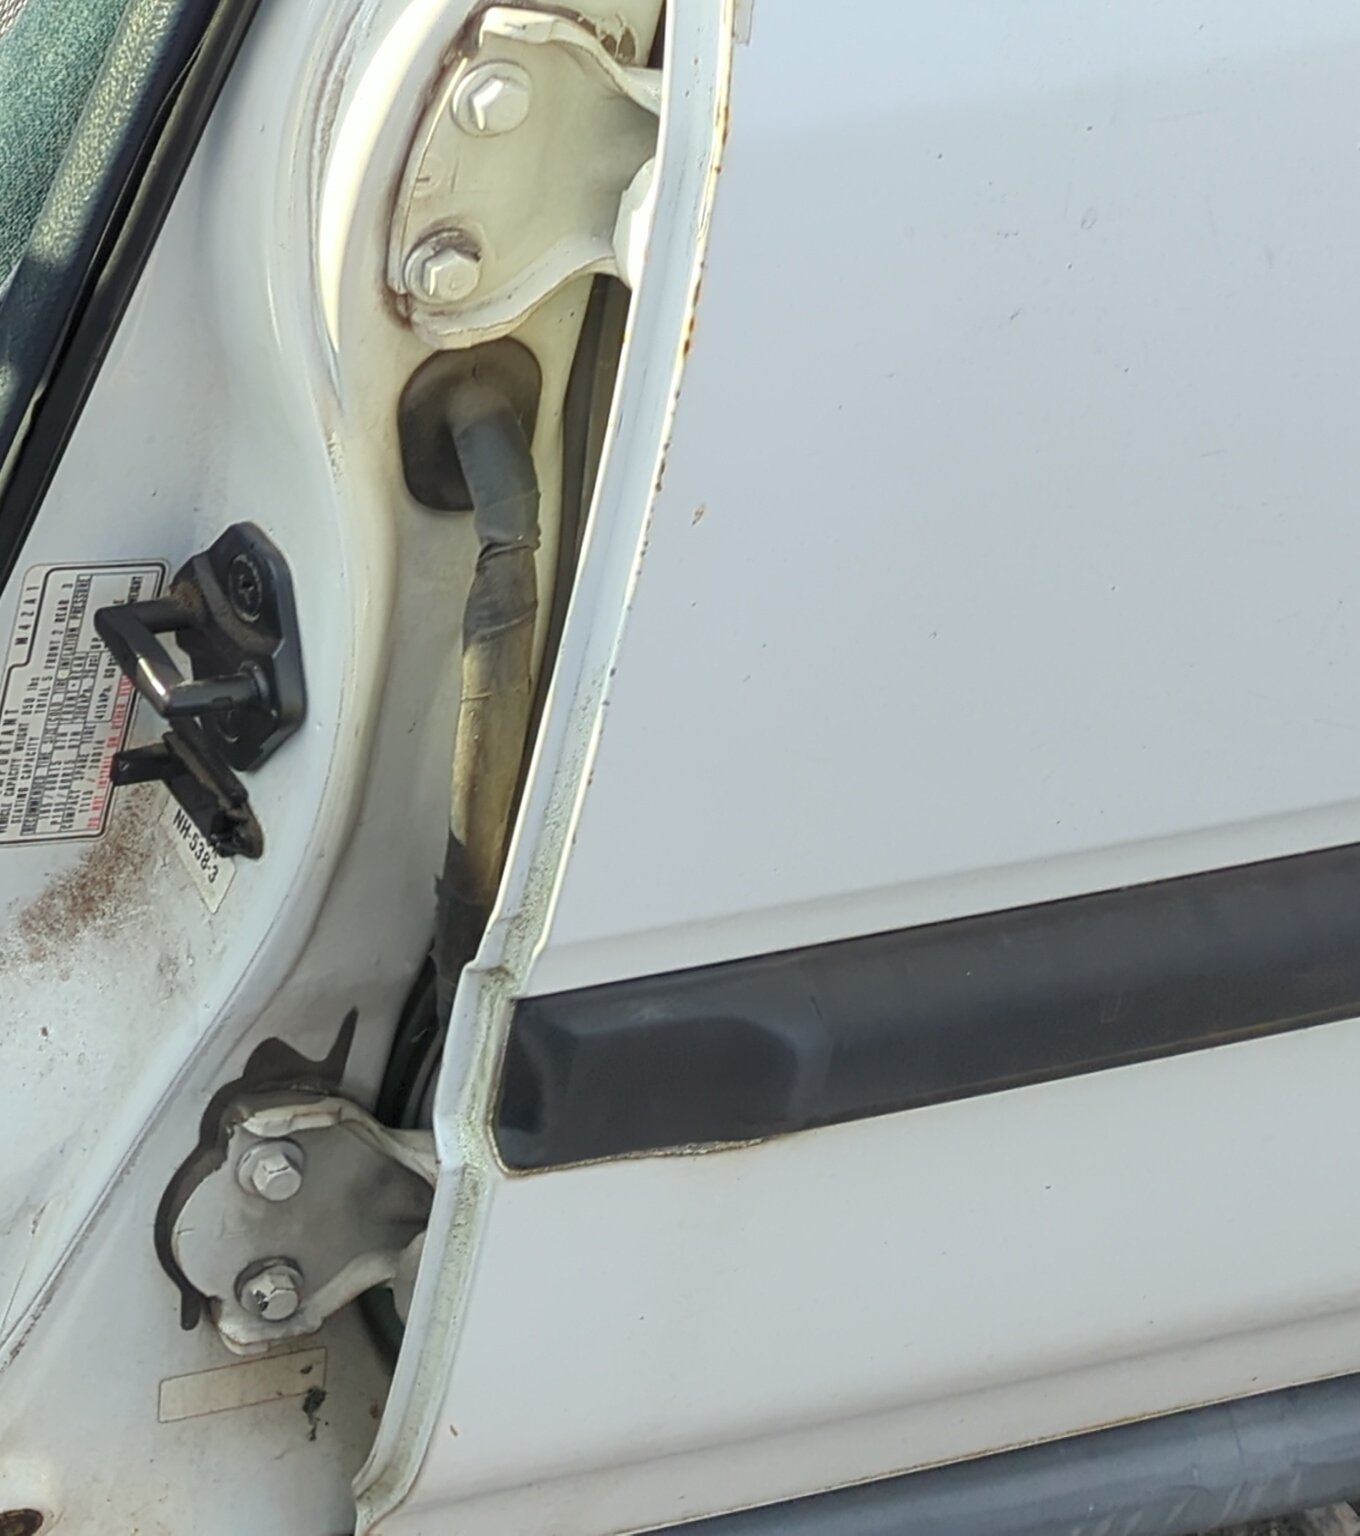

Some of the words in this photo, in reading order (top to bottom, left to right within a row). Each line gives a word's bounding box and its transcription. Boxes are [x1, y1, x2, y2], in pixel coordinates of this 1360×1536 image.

[53, 599, 70, 622] REAR
[43, 640, 61, 669] FRONT
[25, 676, 40, 691] lbs
[33, 686, 51, 713] TOTAL
[12, 722, 30, 752] WEIGHT
[19, 735, 40, 779] CAPACITY
[3, 757, 22, 796] CAPACITY
[10, 787, 29, 824] SEATING
[61, 789, 81, 829] COMPACT
[172, 808, 219, 884] NH-538-3
